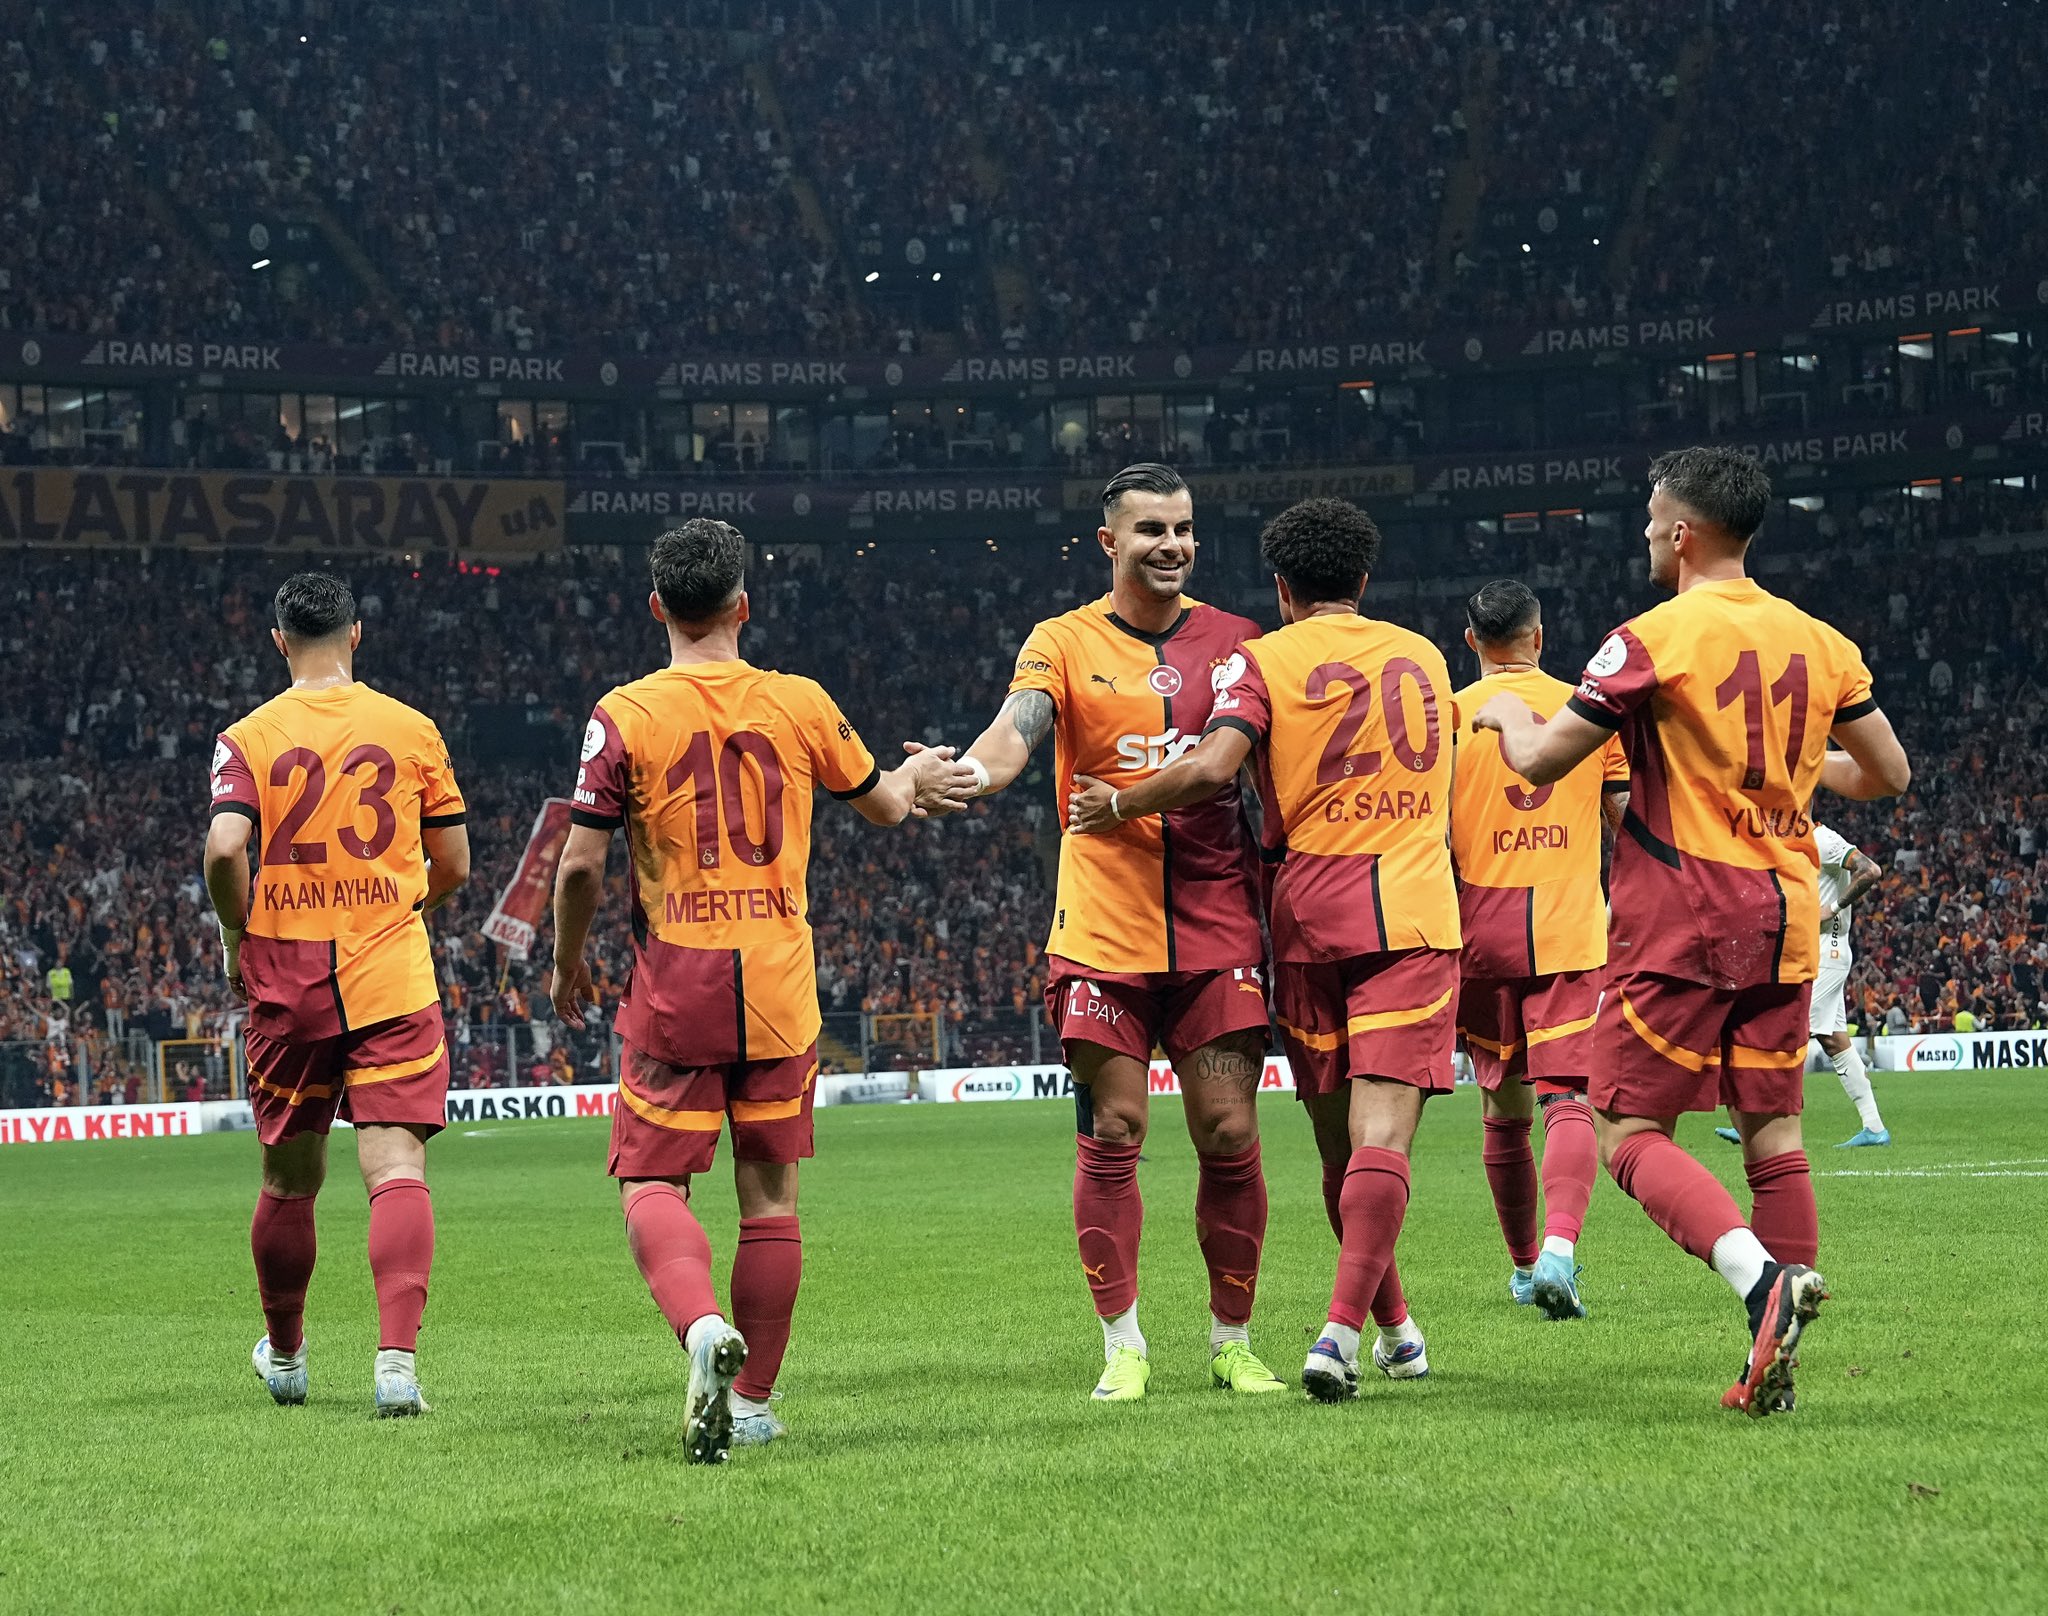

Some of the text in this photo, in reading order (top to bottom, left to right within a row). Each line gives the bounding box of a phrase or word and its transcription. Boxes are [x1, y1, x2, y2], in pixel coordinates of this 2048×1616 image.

[1836, 286, 2000, 326] RAMS PARK
[1547, 317, 1715, 352] RAMS PARK
[108, 341, 281, 370] RAMS PARK
[401, 353, 563, 382] RAMS PARK
[968, 356, 1136, 382] RAMS PARK
[1257, 341, 1426, 372] RAMS PARK
[681, 362, 847, 386] RAMS PARK
[1742, 428, 1909, 464] RAMS PARK
[1451, 457, 1622, 490] RAMS PARK
[0, 470, 488, 548] LATASARAY
[590, 491, 756, 514] RAMS PARK
[875, 487, 1042, 512] RAMS PARK
[1305, 657, 1439, 785] 20
[1715, 650, 1808, 790] 11
[264, 744, 397, 866] 23
[666, 730, 784, 870] 10
[1493, 825, 1568, 855] ICARDI
[264, 877, 399, 910] KAAN AYHAN
[666, 887, 799, 923] MERTENS
[1916, 1049, 1957, 1062] MASKO
[965, 1081, 1012, 1092] MASKO
[447, 1095, 566, 1122] MASKO
